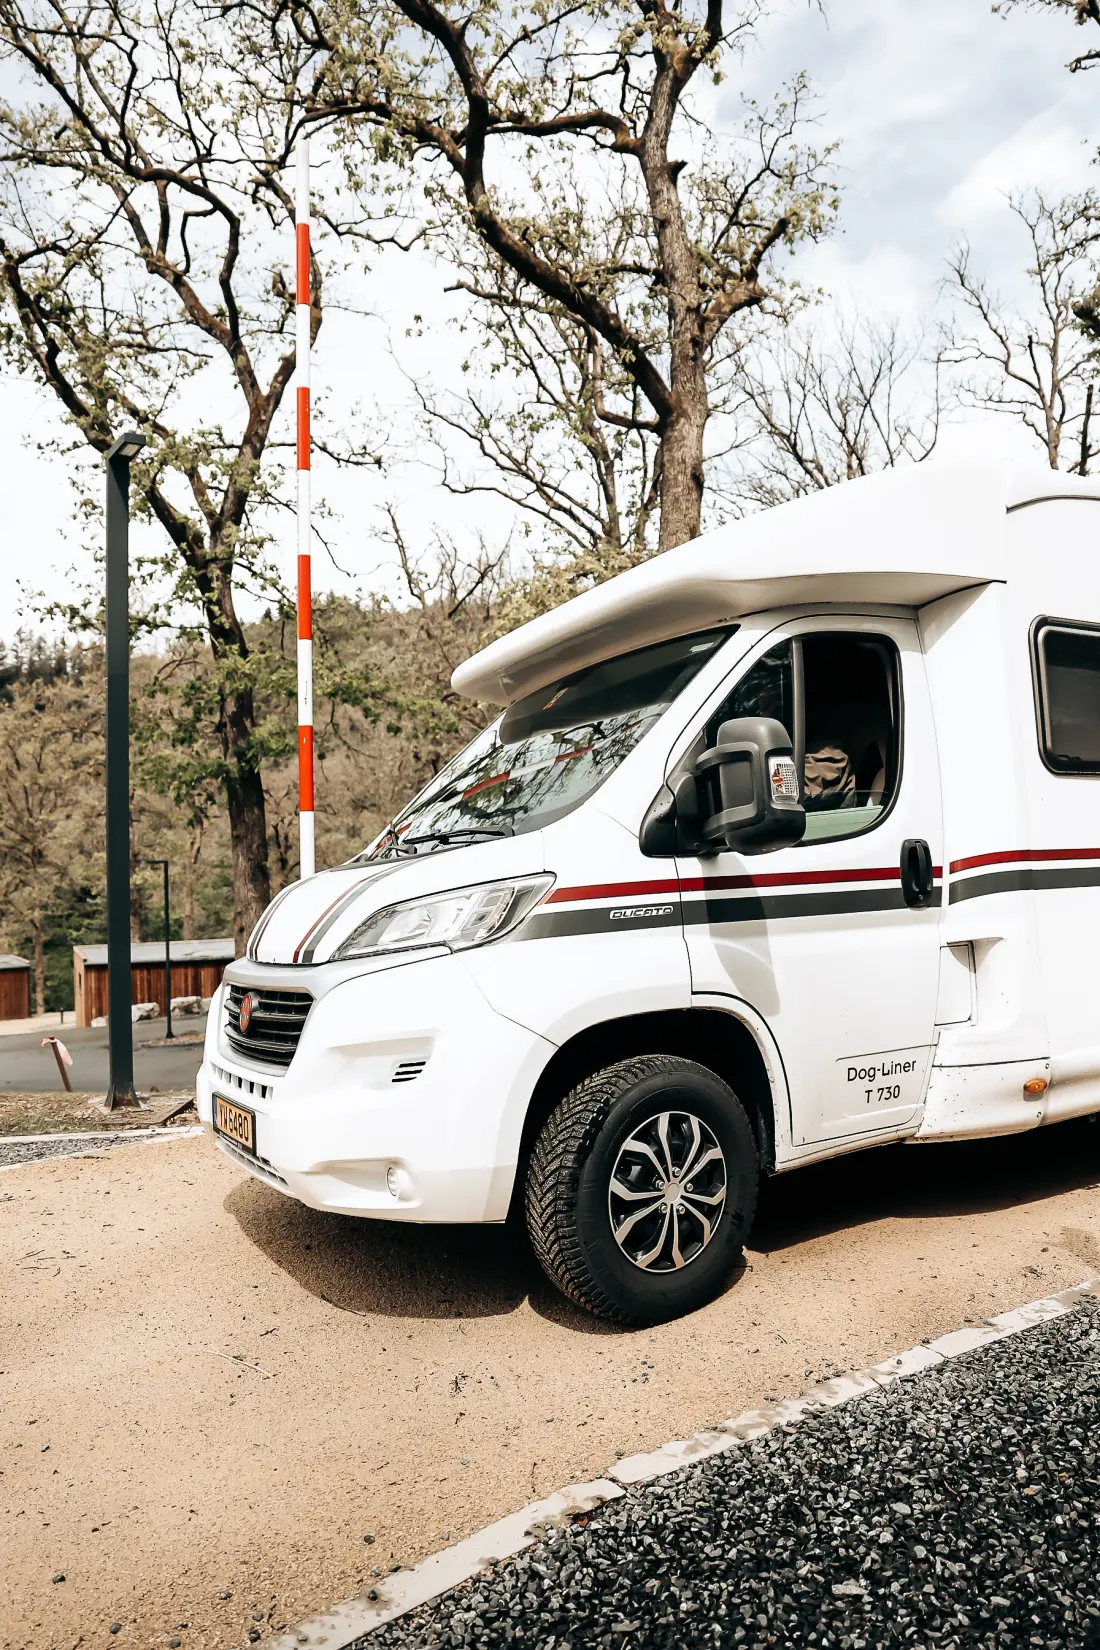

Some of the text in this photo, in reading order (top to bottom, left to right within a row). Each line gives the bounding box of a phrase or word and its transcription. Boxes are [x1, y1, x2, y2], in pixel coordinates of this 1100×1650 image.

[610, 906, 673, 919] DUCATO
[847, 1060, 916, 1082] Dog-Liner
[865, 1084, 901, 1103] T 730
